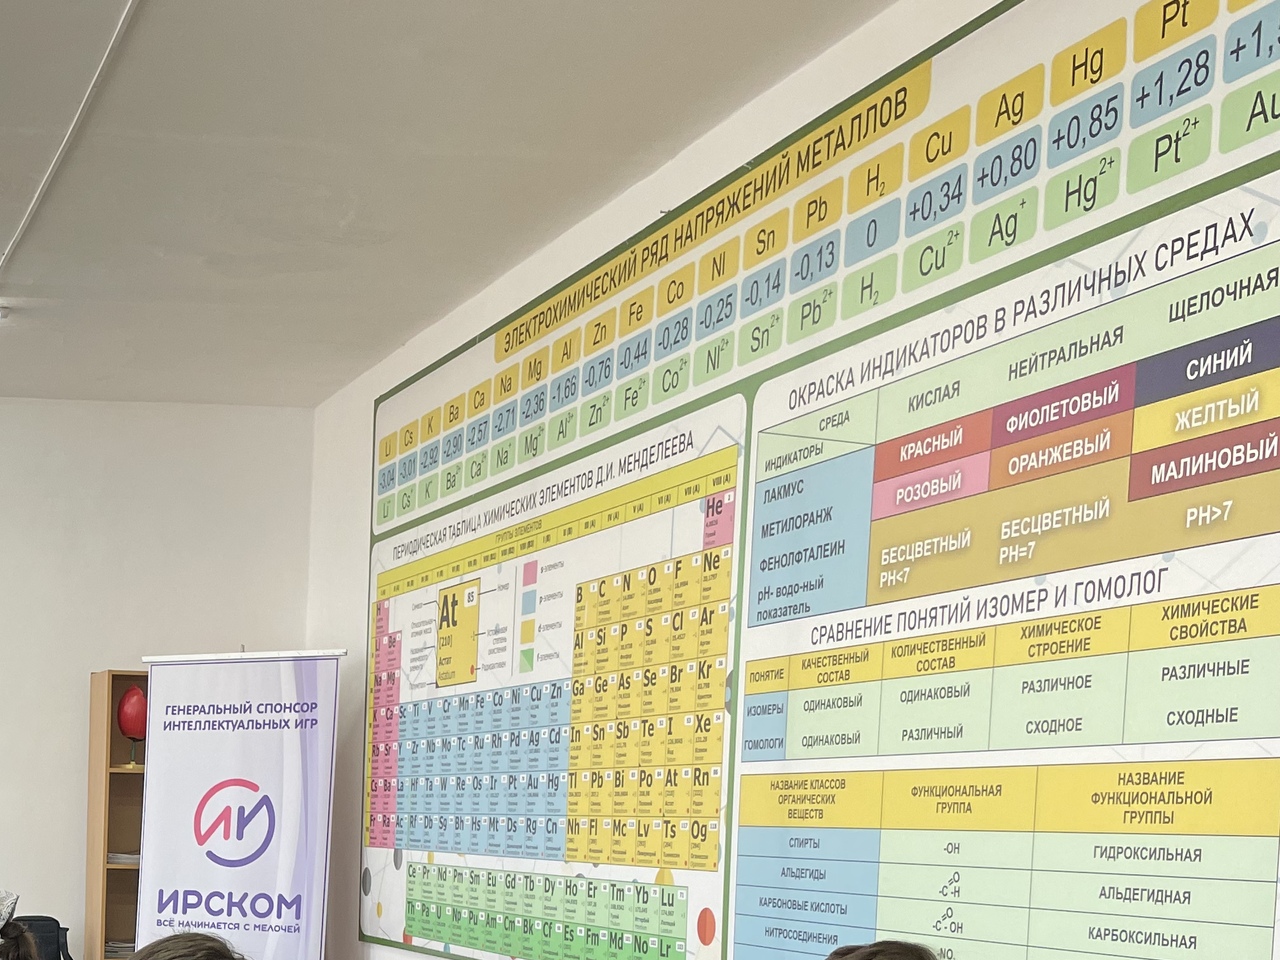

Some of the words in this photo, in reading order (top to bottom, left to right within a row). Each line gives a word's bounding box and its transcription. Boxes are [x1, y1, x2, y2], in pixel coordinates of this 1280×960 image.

[449, 405, 459, 423] Ba
[473, 391, 485, 409] Ca
[500, 375, 512, 396] Na
[528, 358, 542, 381] Mg
[593, 322, 606, 346] Zn
[629, 302, 643, 326] Fe
[667, 280, 684, 304] Co
[756, 229, 775, 255] Sn
[805, 196, 827, 229] Pb
[925, 131, 952, 163] Cu
[995, 91, 1025, 128] Ag
[1072, 48, 1104, 87] Hg
[1161, 0, 1190, 39] Pt
[504, 248, 637, 353] ЭЛЕКТРОХИМИЧЕСКИЙ
[640, 233, 669, 273] РЯД
[674, 151, 790, 252] НАПРЯЖЕНИЙ
[796, 87, 908, 178] МЕТАЛЛОВ
[495, 406, 515, 433] -2,71
[522, 392, 545, 420] -2,36
[552, 375, 576, 404] -1,66
[585, 357, 611, 388] -0,76
[620, 338, 647, 370] -0,44
[658, 317, 688, 351] -0,28
[699, 294, 733, 330] -0,25
[909, 174, 963, 222] +0,34
[977, 137, 1037, 189] +0,80
[1052, 95, 1118, 149] +0,85
[1135, 49, 1210, 110] +1,28
[1169, 267, 1280, 323] ЩЕЛОЧНАЯ
[789, 372, 855, 410] ОКРАСКА
[860, 319, 988, 383] ИНДИКАТОРОВ
[994, 308, 1006, 333] В
[1012, 250, 1147, 328] РАЗЛИЧНЫХ
[1156, 207, 1256, 271] СРЕДАХ
[1009, 326, 1124, 382] НЕЙТРАЛЬНАЯ
[899, 426, 963, 462] КРАСНЫЙ
[1007, 380, 1119, 434] ФИОЛЕТОВЫЙ
[1186, 342, 1253, 380] СИНИЙ
[908, 380, 961, 413] КИСЛАЯ
[819, 410, 850, 432] СРЕДА
[764, 442, 824, 472] ИНДИКАТОРЫ
[896, 472, 962, 505] РОЗОВЫЙ
[1008, 429, 1110, 475] ОРАНЖЕВЫЙ
[1175, 391, 1259, 432] ЖЕЛТЫЙ
[1151, 435, 1279, 485] МАЛИНОВЫЙ
[393, 526, 447, 561] ПЕРИОДИЧЕСКАЯ
[448, 515, 482, 541] ТАБЛИЦА
[483, 491, 537, 528] ХИМИЧЕСКИХ
[538, 469, 594, 507] ЭЛЕМЕНТОВ
[618, 430, 694, 476] МЕНДЕЛЕЕВА
[763, 480, 804, 505] ЛАКМУС
[706, 498, 722, 518] He
[761, 507, 833, 539] МЕТИЛОРАНЖ
[1000, 499, 1110, 541] БЕСЦВЕТНЫЙ
[759, 539, 845, 572] ФЕНОЛФТАЛЕИН
[881, 528, 971, 565] БЕСЦВЕТНЫЙ
[703, 553, 720, 572] Ne
[439, 593, 458, 630] At
[700, 607, 714, 626] Ar
[757, 601, 811, 622] показатель
[812, 613, 892, 645] СРАВНЕНИЕ
[897, 596, 971, 634] ПОНЯТИЙ
[976, 589, 1048, 620] ИЗОМЕР
[1054, 585, 1069, 607] И
[1075, 568, 1168, 604] ГОМОЛОГ
[1161, 595, 1259, 622] ХИМИЧЕСКИЕ
[1021, 616, 1102, 641] ХИМИЧЕСКОЕ
[1170, 617, 1247, 641] СВОЙСТВА
[891, 633, 986, 659] КОЛИЧЕСТВЕННЫЙ
[1028, 639, 1091, 658] СТРОЕНИЕ
[802, 650, 870, 670] КАЧЕСТВЕННЫЙ
[916, 656, 956, 672] СОСТАВ
[670, 665, 683, 683] Br
[698, 660, 712, 679] Kr
[749, 668, 785, 683] ПОНЯТИЕ
[817, 670, 850, 683] СОСТАВ
[1162, 659, 1250, 682] РАЗЛИЧНЫЕ
[900, 682, 971, 703] ОДИНАКОВЫЙ
[1021, 675, 1092, 695] РАЗЛИЧНОЕ
[166, 701, 252, 715] ГЕНЕРАЛЬНЫЙ
[256, 702, 317, 714] СПОНСОР
[747, 702, 784, 717] ИЗОМЕРЫ
[803, 695, 862, 713] ОДИНАКОВЫЙ
[163, 719, 290, 732] ИНТЕЛЛЕКТУАЛЬНЫХ
[295, 719, 318, 730] ИГР
[642, 720, 654, 737] Te
[695, 714, 711, 733] Xe
[1026, 717, 1082, 734] СХОДНОЕ
[1166, 707, 1238, 727] СХОДНЫЕ
[802, 730, 860, 748] ОДИНАКОВЫЙ
[902, 723, 963, 741] РАЗЛИЧНЫЙ
[744, 736, 784, 751] ГОМОЛОГИ
[694, 768, 709, 786] Rn
[770, 780, 808, 791] НАЗВАНИЕ
[810, 779, 846, 790] КЛАССОВ
[1118, 771, 1184, 786] НАЗВАНИЕ
[778, 793, 836, 805] ОРГАНИЧЕСКИХ
[911, 784, 1002, 799] ФУНКЦИОНАЛЬНАЯ
[1092, 789, 1212, 808] ФУНКЦИОНАЛЬНОЙ
[788, 808, 824, 820] ВЕЩЕСТВ
[936, 801, 972, 814] ГРУППА
[1123, 810, 1174, 825] ГРУППЫ
[663, 821, 676, 838] Ts
[691, 821, 707, 842] Og
[789, 837, 820, 849] СПИРТЫ
[1094, 846, 1202, 862] ГИДРОКСИЛЬНАЯ
[781, 867, 826, 880] АЛЬДЕГИДЫ
[157, 889, 301, 920] ИРСКОМ
[661, 888, 674, 907] Lu
[1099, 886, 1191, 905] АЛЬДЕГИДНАЯ
[759, 897, 808, 913] КАРБОНОВЫЕ
[810, 901, 847, 915] КИСЛОТЫ
[157, 918, 174, 927] ВСЁ
[178, 921, 240, 930] НАЧИНАЕТСЯ
[244, 923, 250, 931] С
[253, 923, 300, 933] МЕЛОЧЕЙ
[765, 927, 838, 945] НИТРОСОЕДИНЕНИЯ
[1088, 926, 1197, 949] КАРБОКСИЛЬНАЯ
